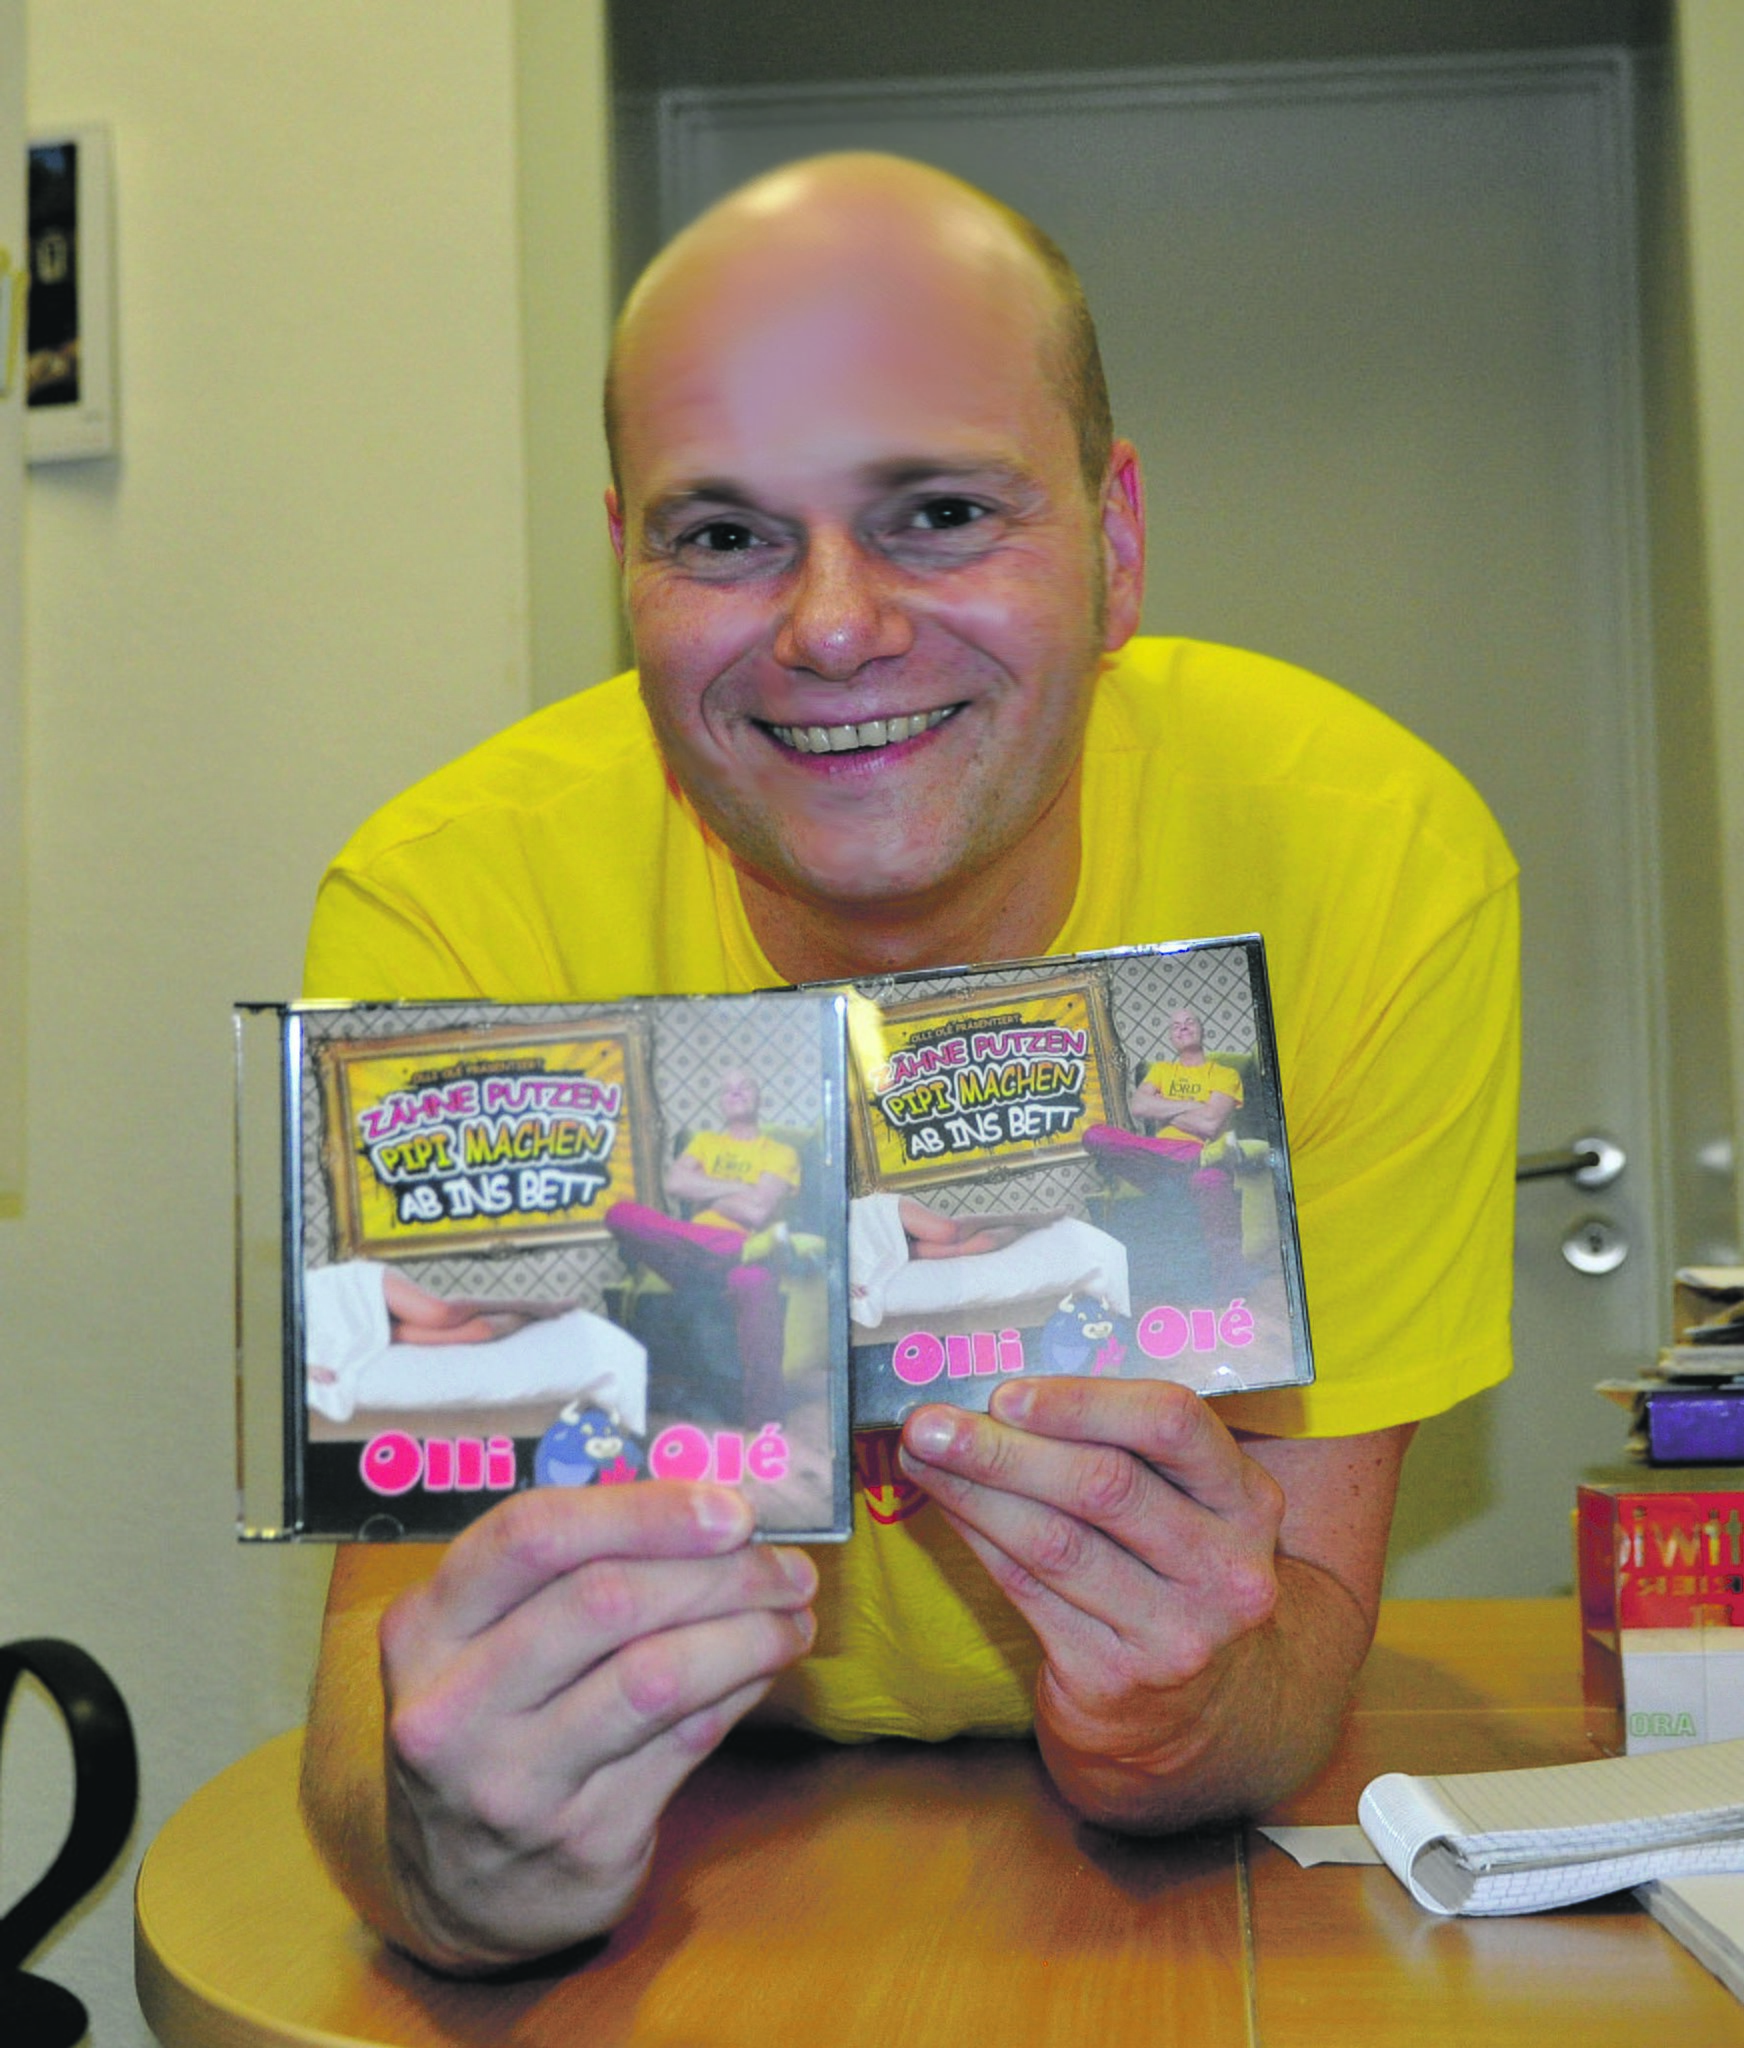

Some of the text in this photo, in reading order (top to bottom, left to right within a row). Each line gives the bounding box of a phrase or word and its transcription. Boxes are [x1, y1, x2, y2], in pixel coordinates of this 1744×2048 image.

[872, 1030, 1085, 1093] ZÄHNE PUTZEN
[886, 1061, 1077, 1118] PIPI MACHEN
[361, 1080, 620, 1140] ZÄHNE PUTZEN
[911, 1104, 1081, 1156] AB INS BETT
[377, 1119, 606, 1173] PIPI MACHEN
[400, 1169, 606, 1221] AB INS BETT
[892, 1298, 1255, 1385] Olli Olé
[360, 1423, 789, 1495] Olli Olé
[1629, 1712, 1697, 1737] ORA
